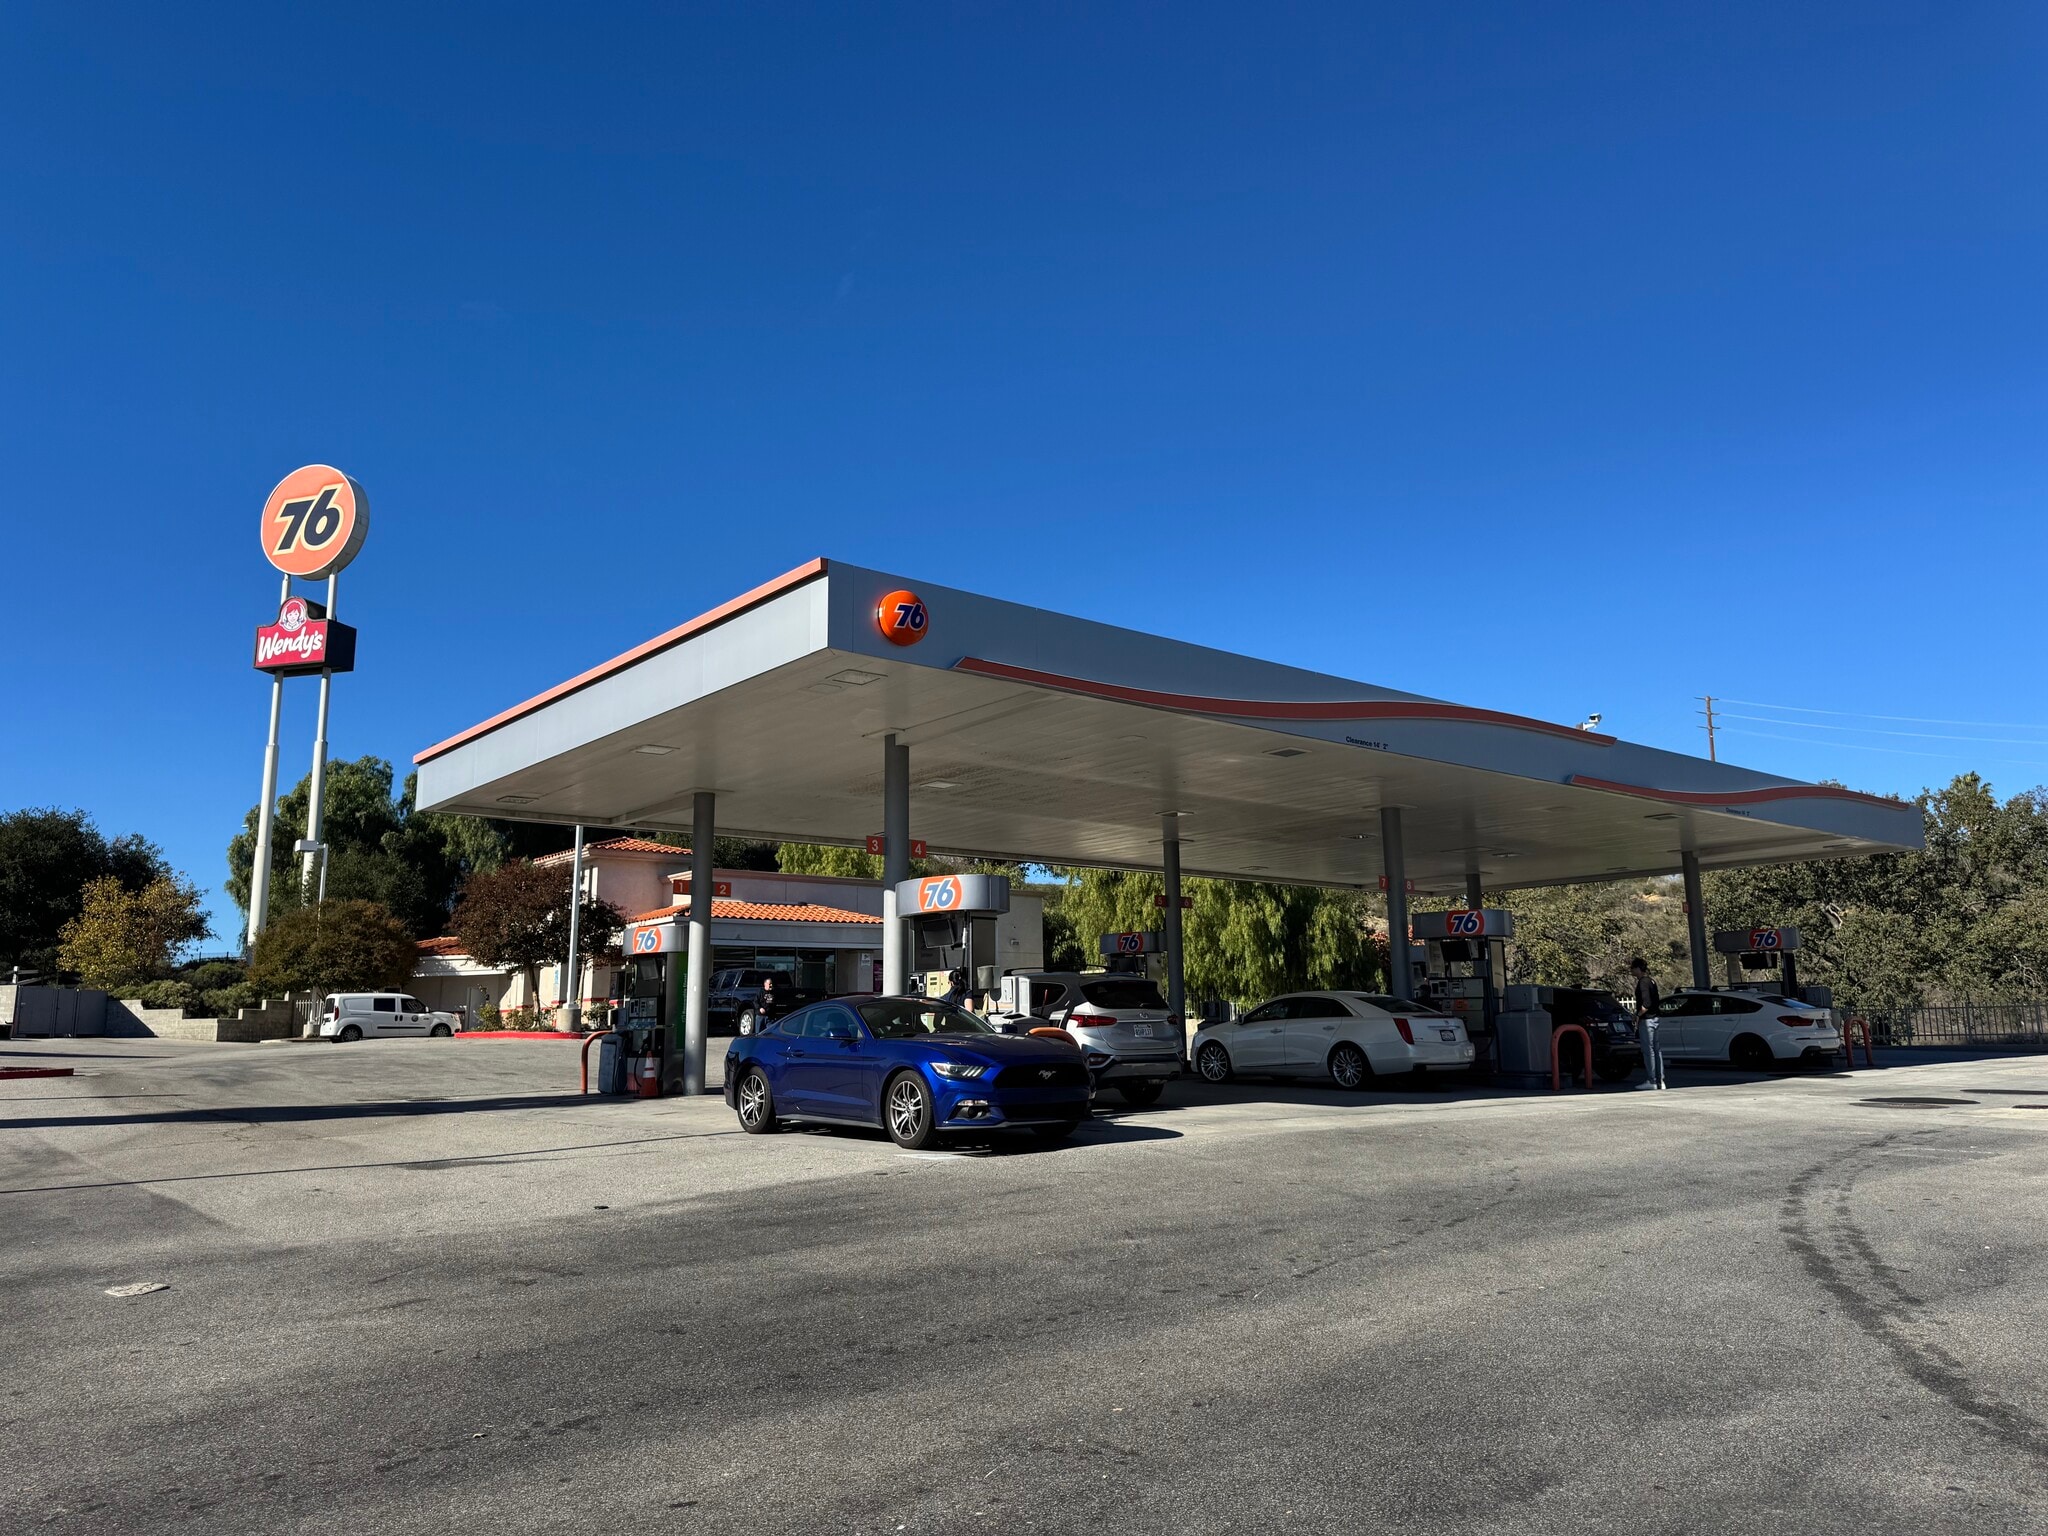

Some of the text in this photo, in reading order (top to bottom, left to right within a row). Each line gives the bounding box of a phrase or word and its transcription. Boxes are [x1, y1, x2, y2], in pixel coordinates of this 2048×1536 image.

[272, 483, 344, 556] 76
[894, 603, 926, 631] 76
[258, 626, 323, 662] Wendy's
[1345, 736, 1373, 748] Clearance
[871, 839, 880, 852] 3
[914, 843, 922, 855] 4
[719, 884, 727, 895] 2
[1381, 877, 1386, 888] 7
[1406, 880, 1412, 890] 8
[924, 877, 956, 910] 76
[1451, 911, 1480, 934] 76
[636, 928, 658, 952] 76
[1120, 933, 1140, 951] 76
[1753, 930, 1778, 948] 76
